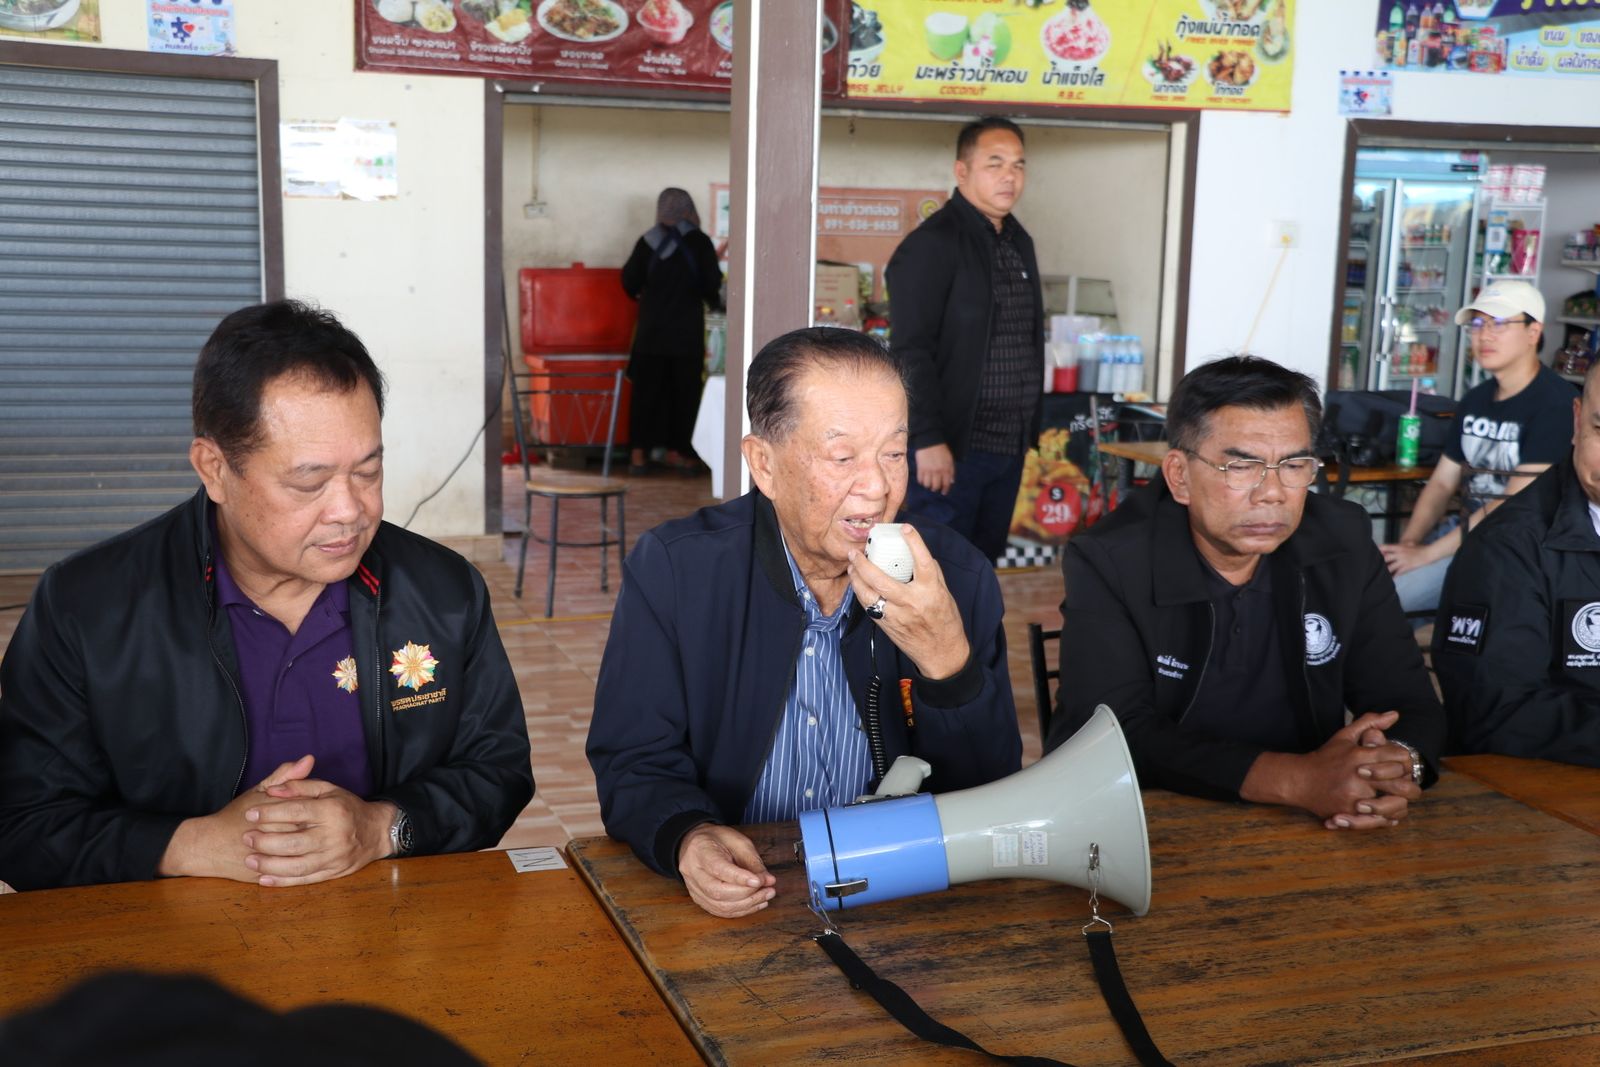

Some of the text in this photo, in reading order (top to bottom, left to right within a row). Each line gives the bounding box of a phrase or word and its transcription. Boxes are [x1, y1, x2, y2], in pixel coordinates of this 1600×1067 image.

[915, 58, 1028, 84] มะพร้าวน้ำหอม
[1042, 61, 1105, 86] น้ำแข็งใส
[939, 85, 986, 97] COCONUT
[1051, 487, 1063, 500] S
[428, 695, 446, 705] PARTY
